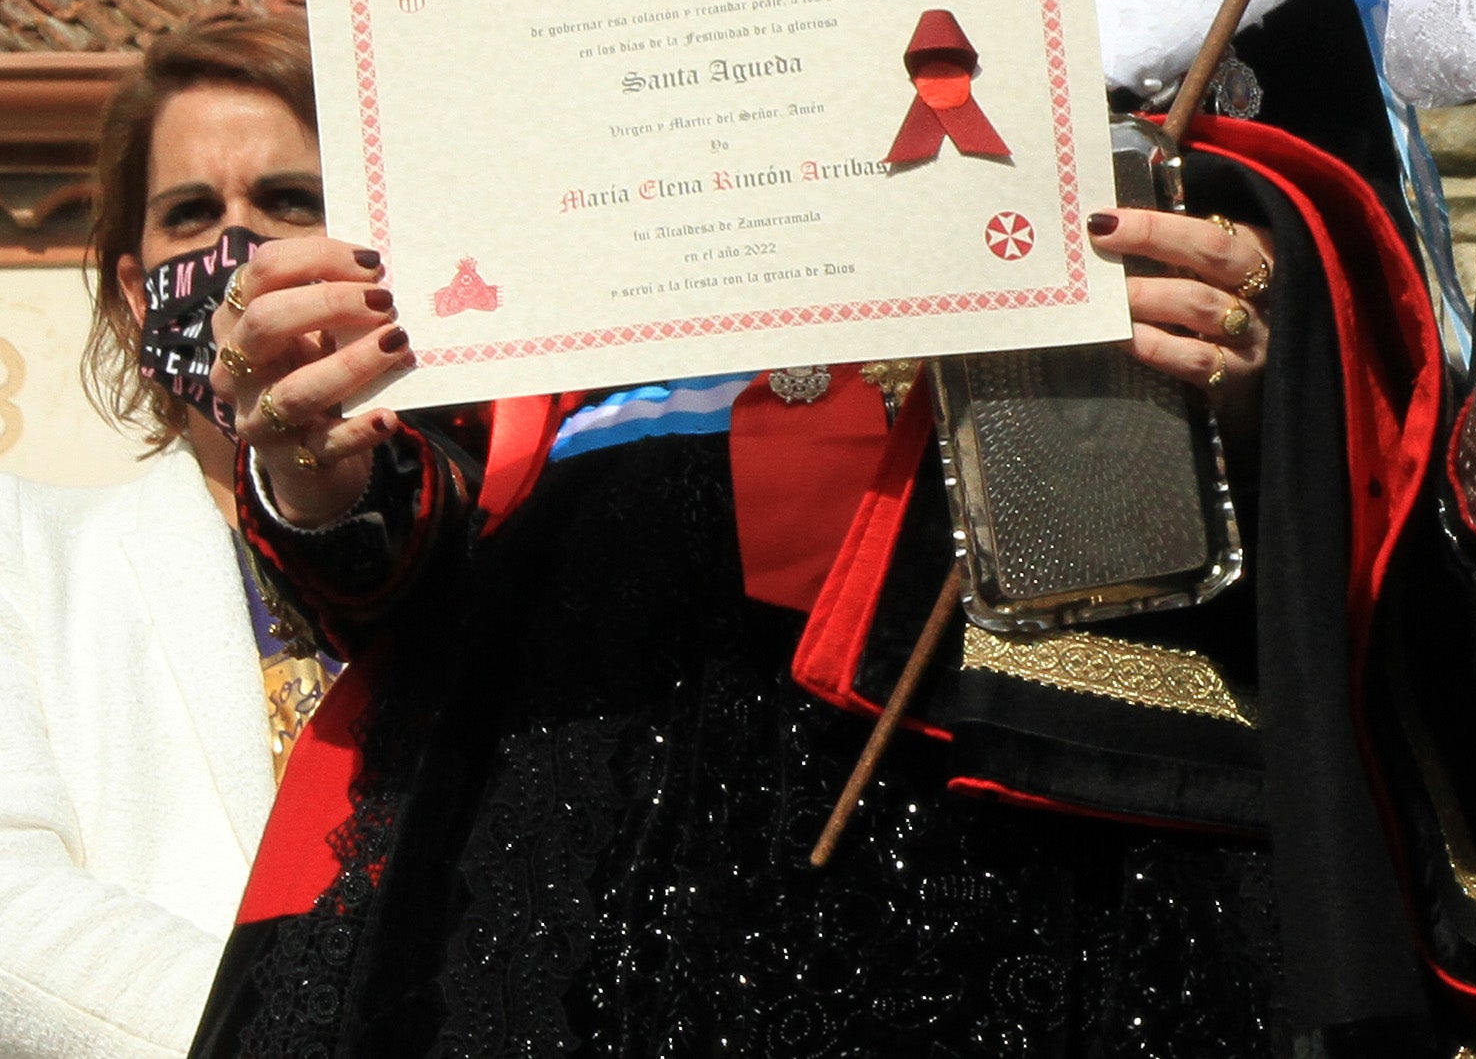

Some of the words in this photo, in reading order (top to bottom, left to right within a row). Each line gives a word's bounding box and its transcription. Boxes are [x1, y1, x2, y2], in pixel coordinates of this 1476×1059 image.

[531, 27, 543, 37] de
[548, 21, 601, 37] gobernar
[608, 17, 627, 27] esa
[579, 49, 593, 58] en
[597, 45, 615, 55] los
[649, 39, 661, 48] de
[667, 36, 677, 46] la
[686, 27, 749, 45] Festividad
[754, 26, 766, 36] de
[771, 23, 782, 33] la
[787, 19, 838, 34] gloriosa
[621, 68, 699, 94] Santa
[709, 55, 802, 84] Agueda
[609, 125, 652, 137] Virgen
[717, 112, 734, 124] del
[711, 140, 729, 154] Yo
[560, 184, 630, 213] María
[638, 179, 703, 200] Elena
[712, 165, 792, 191] Rincón
[801, 158, 888, 181] Arribas
[633, 230, 650, 241] fui
[656, 224, 714, 239] Alcaldesa
[719, 221, 731, 231] de
[738, 211, 821, 229] Zamarramala
[684, 254, 698, 262] en
[703, 249, 713, 260] el
[718, 246, 739, 258] año
[745, 242, 776, 256] 2022
[658, 284, 664, 292] a
[669, 281, 680, 291] la
[684, 277, 718, 289] fiesta
[723, 276, 743, 285] con
[747, 273, 759, 282] la
[763, 269, 801, 283] gracia
[805, 266, 818, 277] de
[823, 263, 855, 275] Dios
